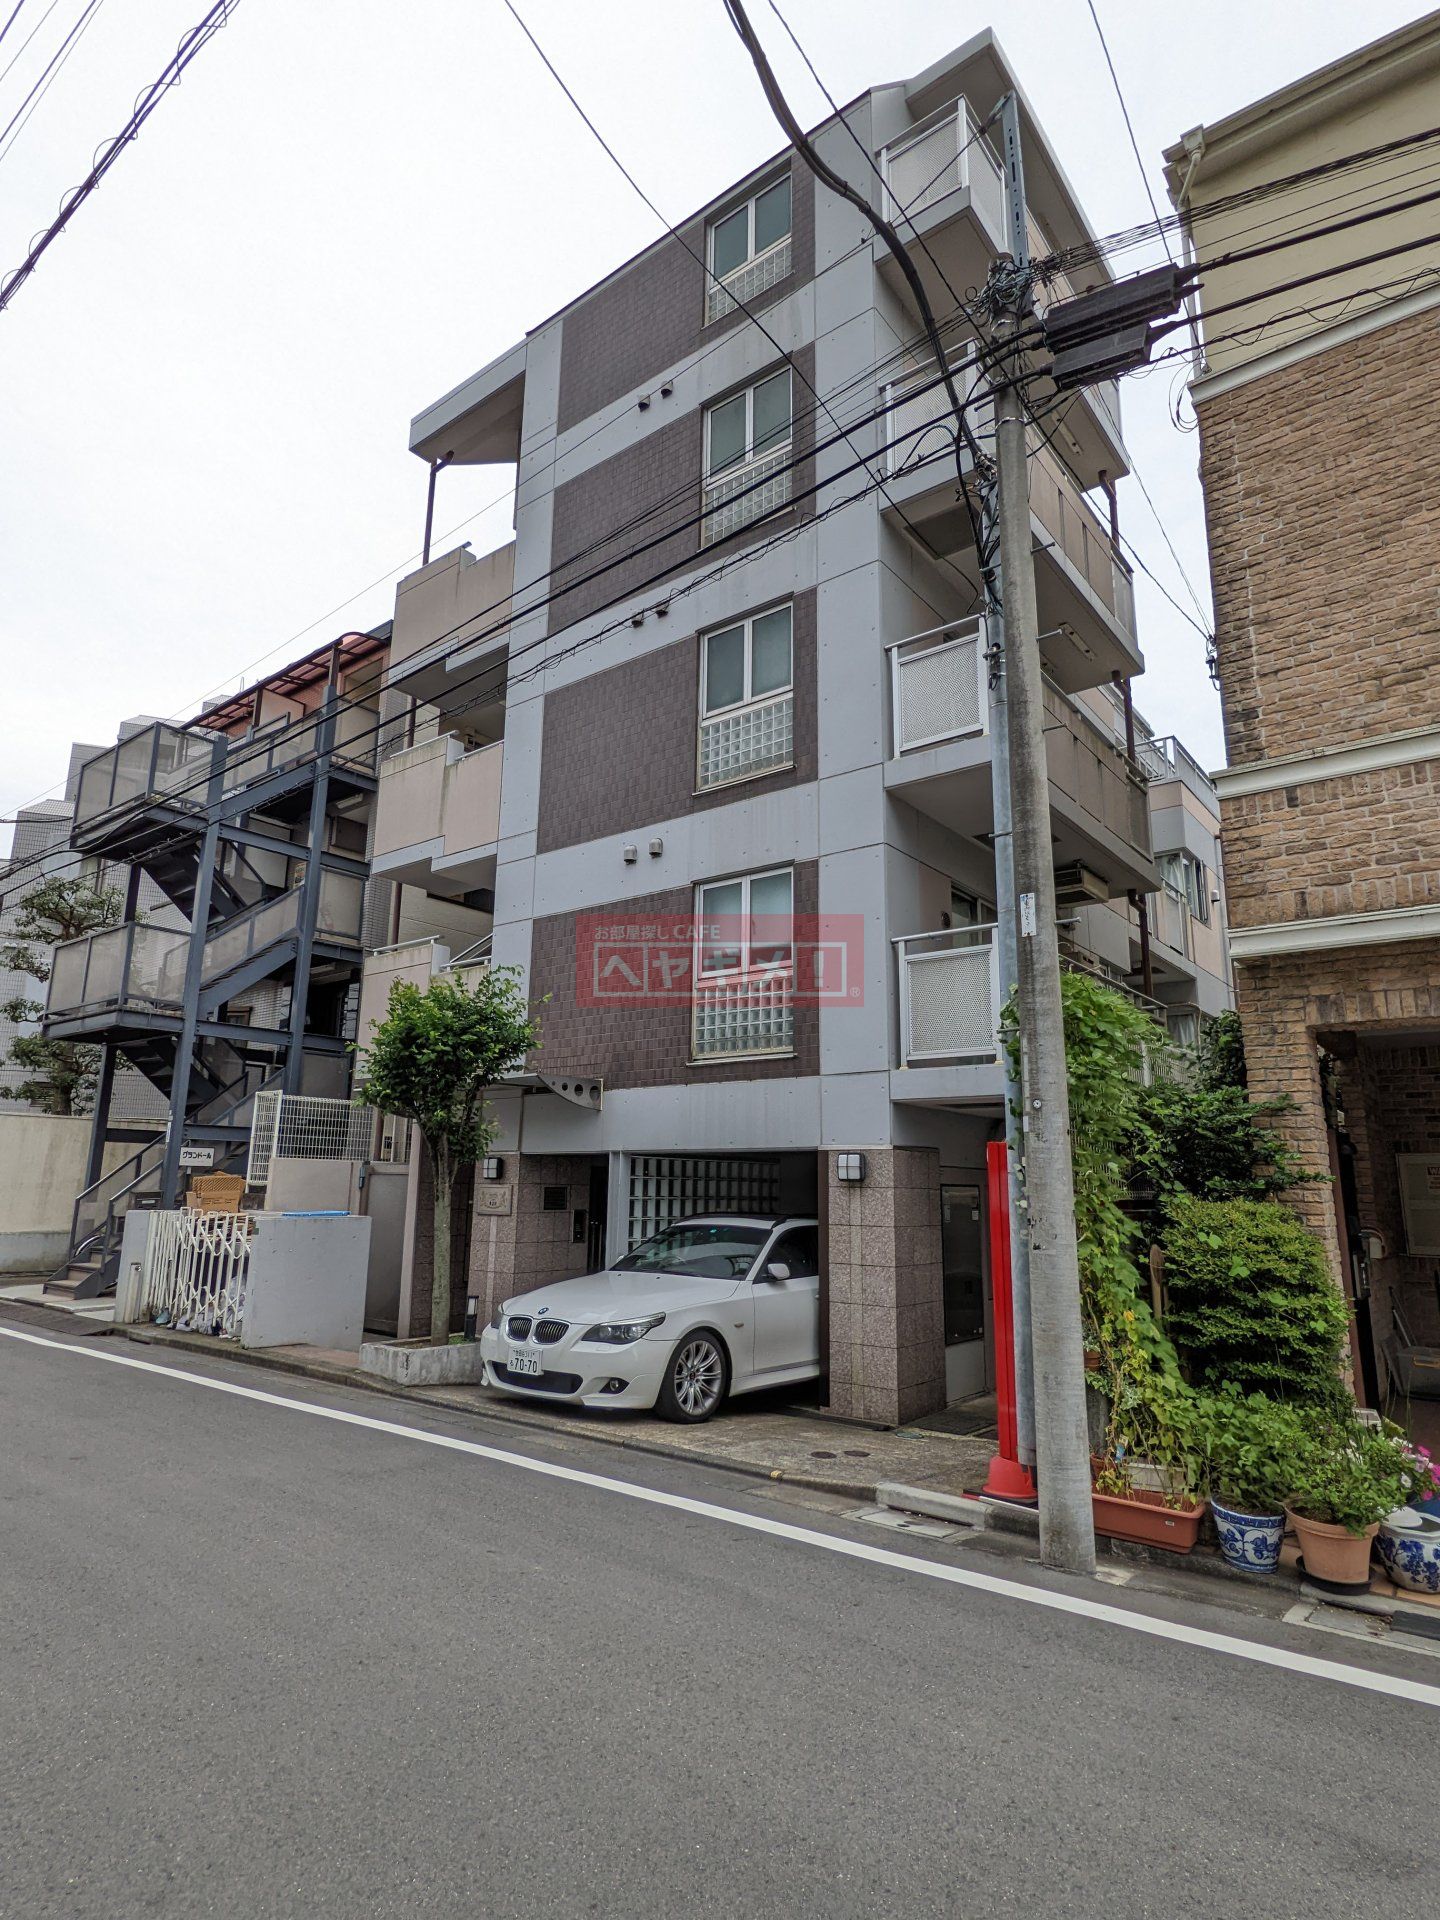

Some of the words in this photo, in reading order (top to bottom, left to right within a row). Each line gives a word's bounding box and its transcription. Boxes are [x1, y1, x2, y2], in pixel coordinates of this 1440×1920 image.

[182, 1150, 212, 1159] グランドール
[515, 1358, 538, 1373] 70-70
